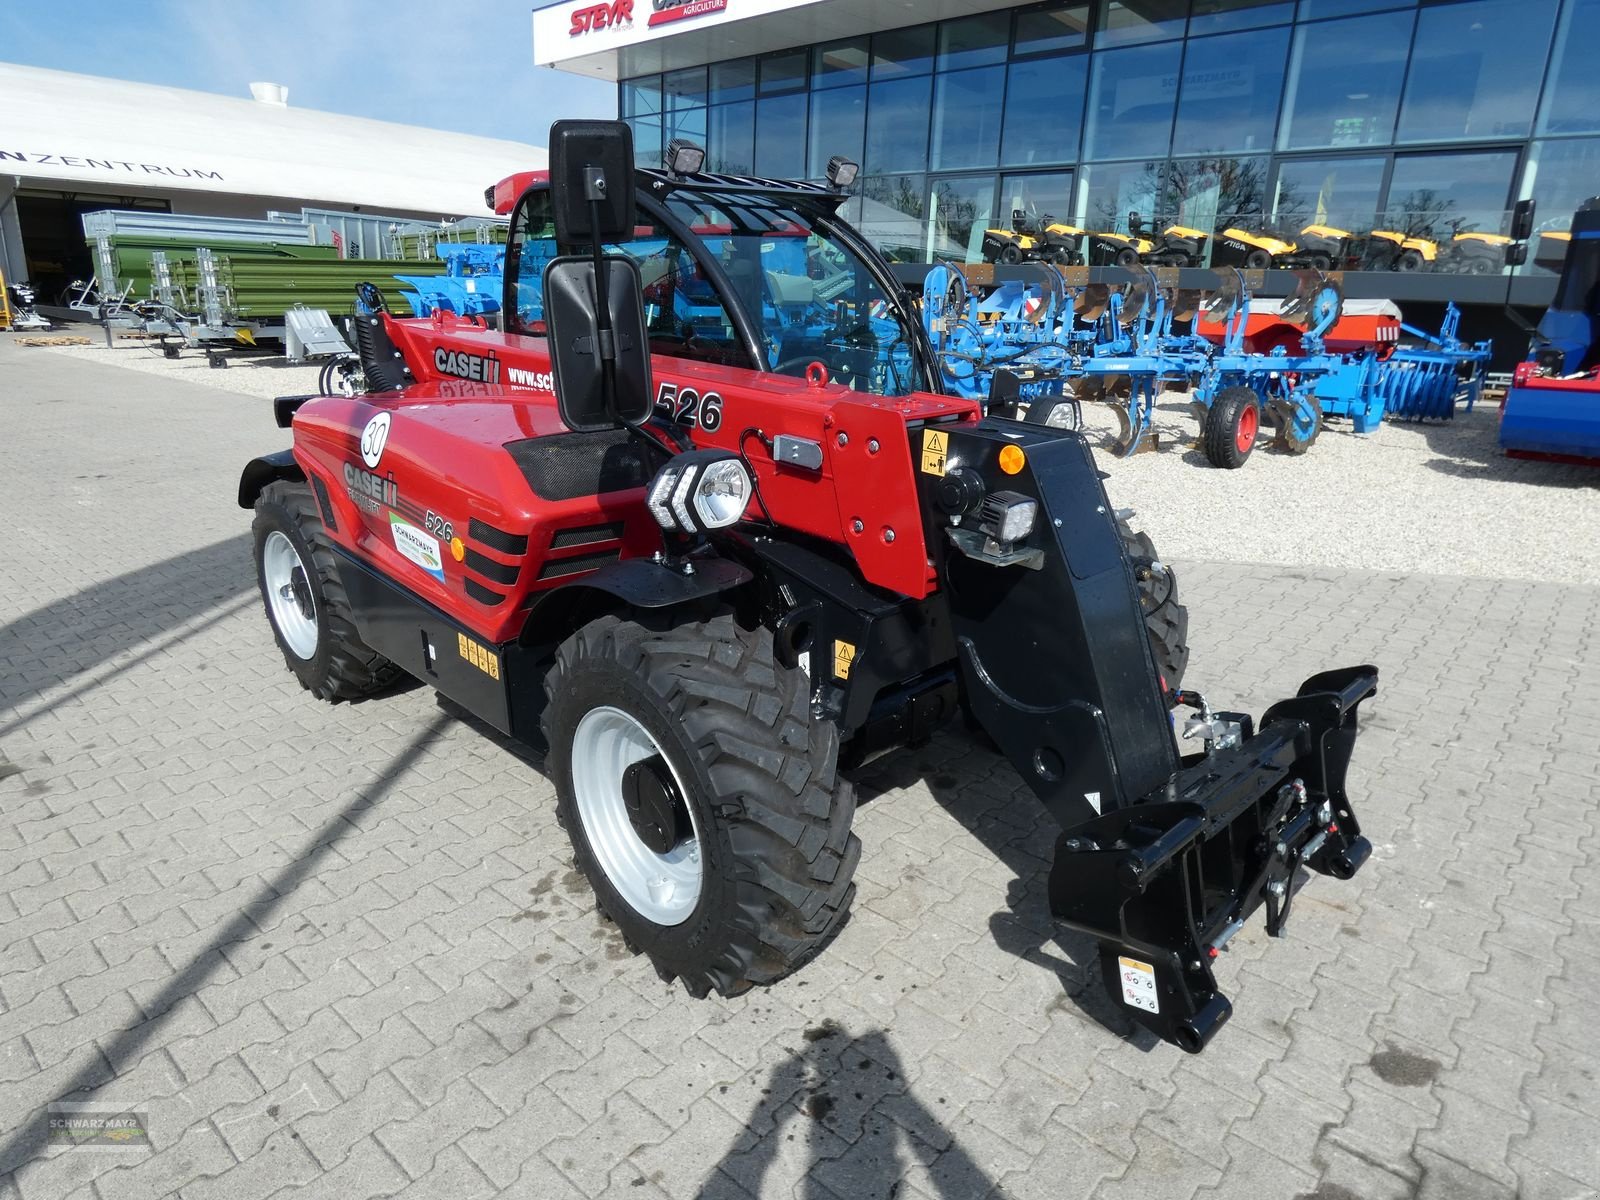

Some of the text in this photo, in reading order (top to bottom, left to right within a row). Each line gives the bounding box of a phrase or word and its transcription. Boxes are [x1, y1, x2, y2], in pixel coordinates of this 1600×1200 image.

[569, 0, 634, 35] STEYR
[683, 1, 724, 15] AGRICULTURE
[1224, 240, 1246, 251] STIGA
[656, 382, 724, 433] 526
[363, 421, 387, 457] 30
[425, 509, 453, 545] 526
